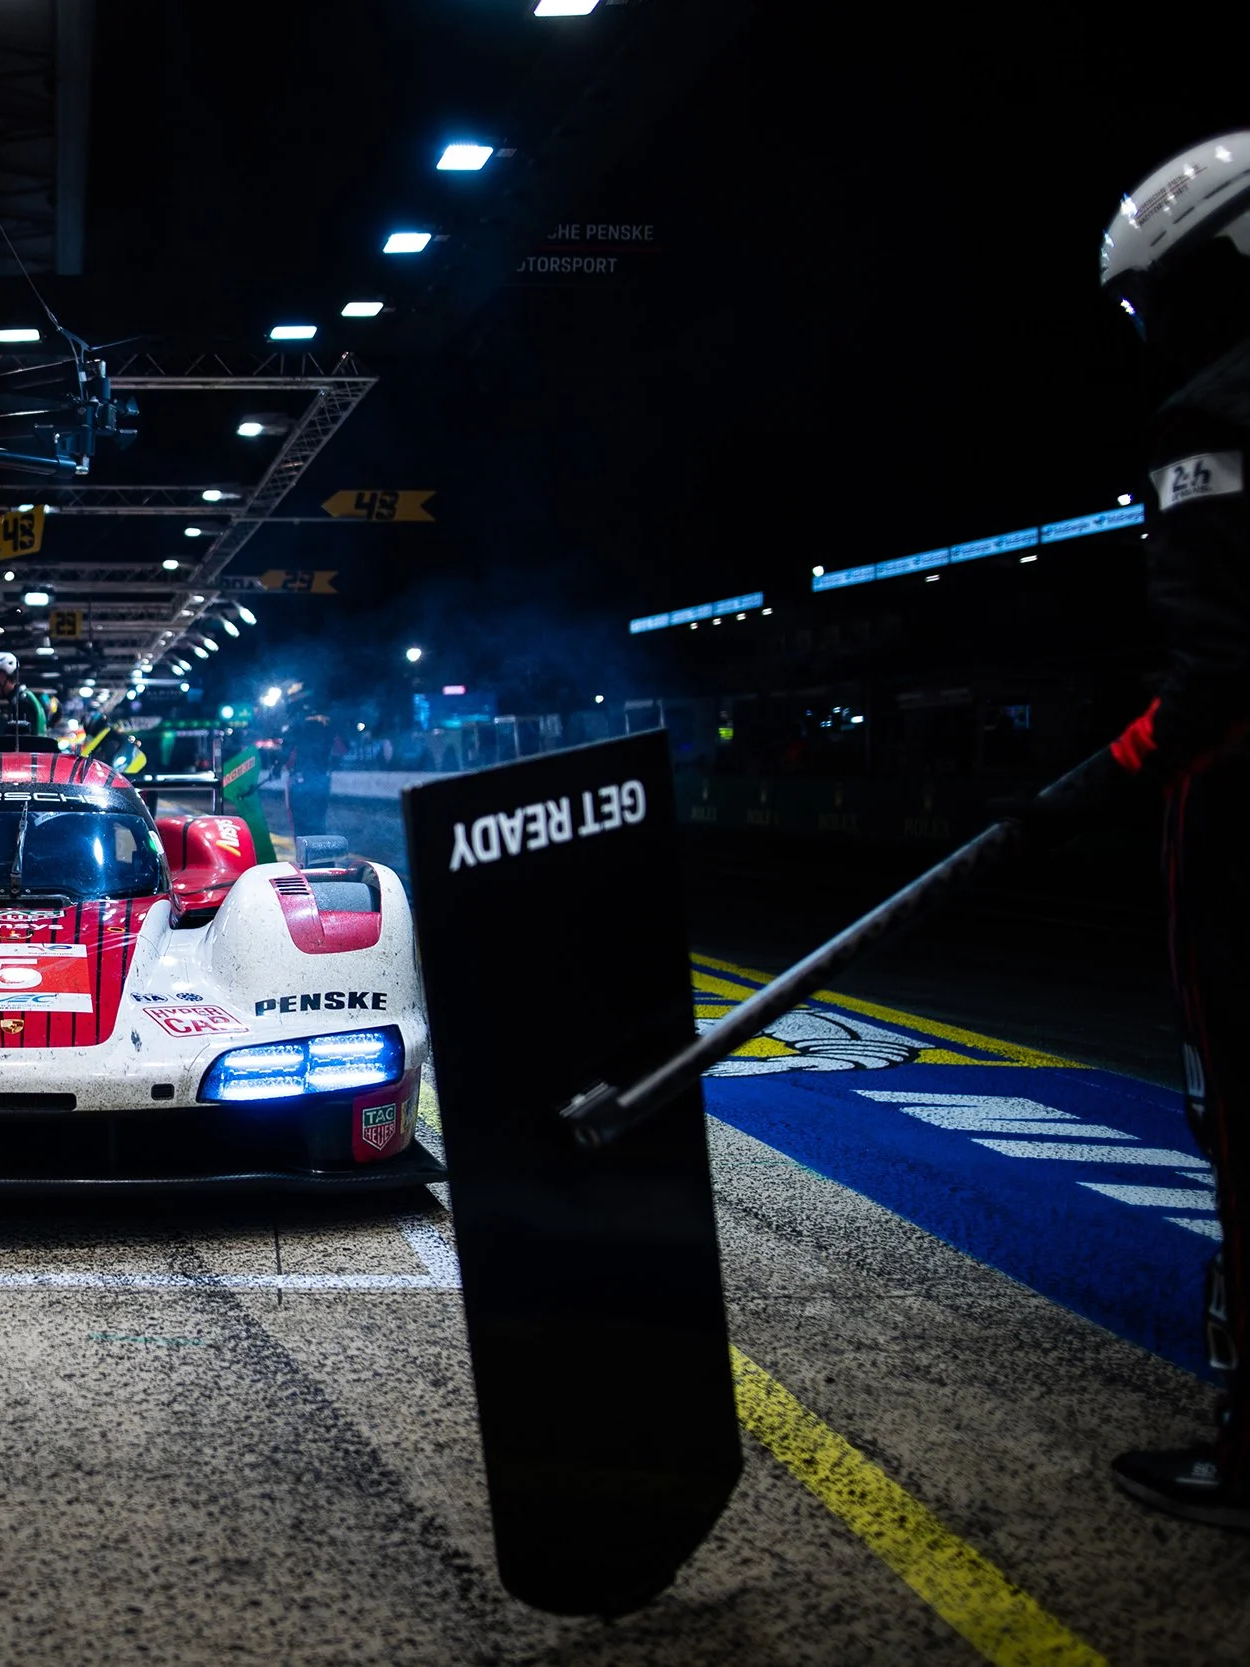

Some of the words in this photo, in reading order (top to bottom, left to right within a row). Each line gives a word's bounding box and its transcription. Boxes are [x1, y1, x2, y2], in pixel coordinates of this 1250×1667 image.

[585, 223, 654, 241] PENSKE
[355, 491, 399, 521] 48
[2, 512, 35, 553] 48
[55, 611, 76, 635] 29
[577, 779, 647, 837] GET
[449, 796, 574, 872] READY
[150, 1007, 223, 1018] HYPER
[255, 991, 387, 1016] PENSKE
[366, 1107, 394, 1124] TAG
[365, 1123, 394, 1146] HEUER
